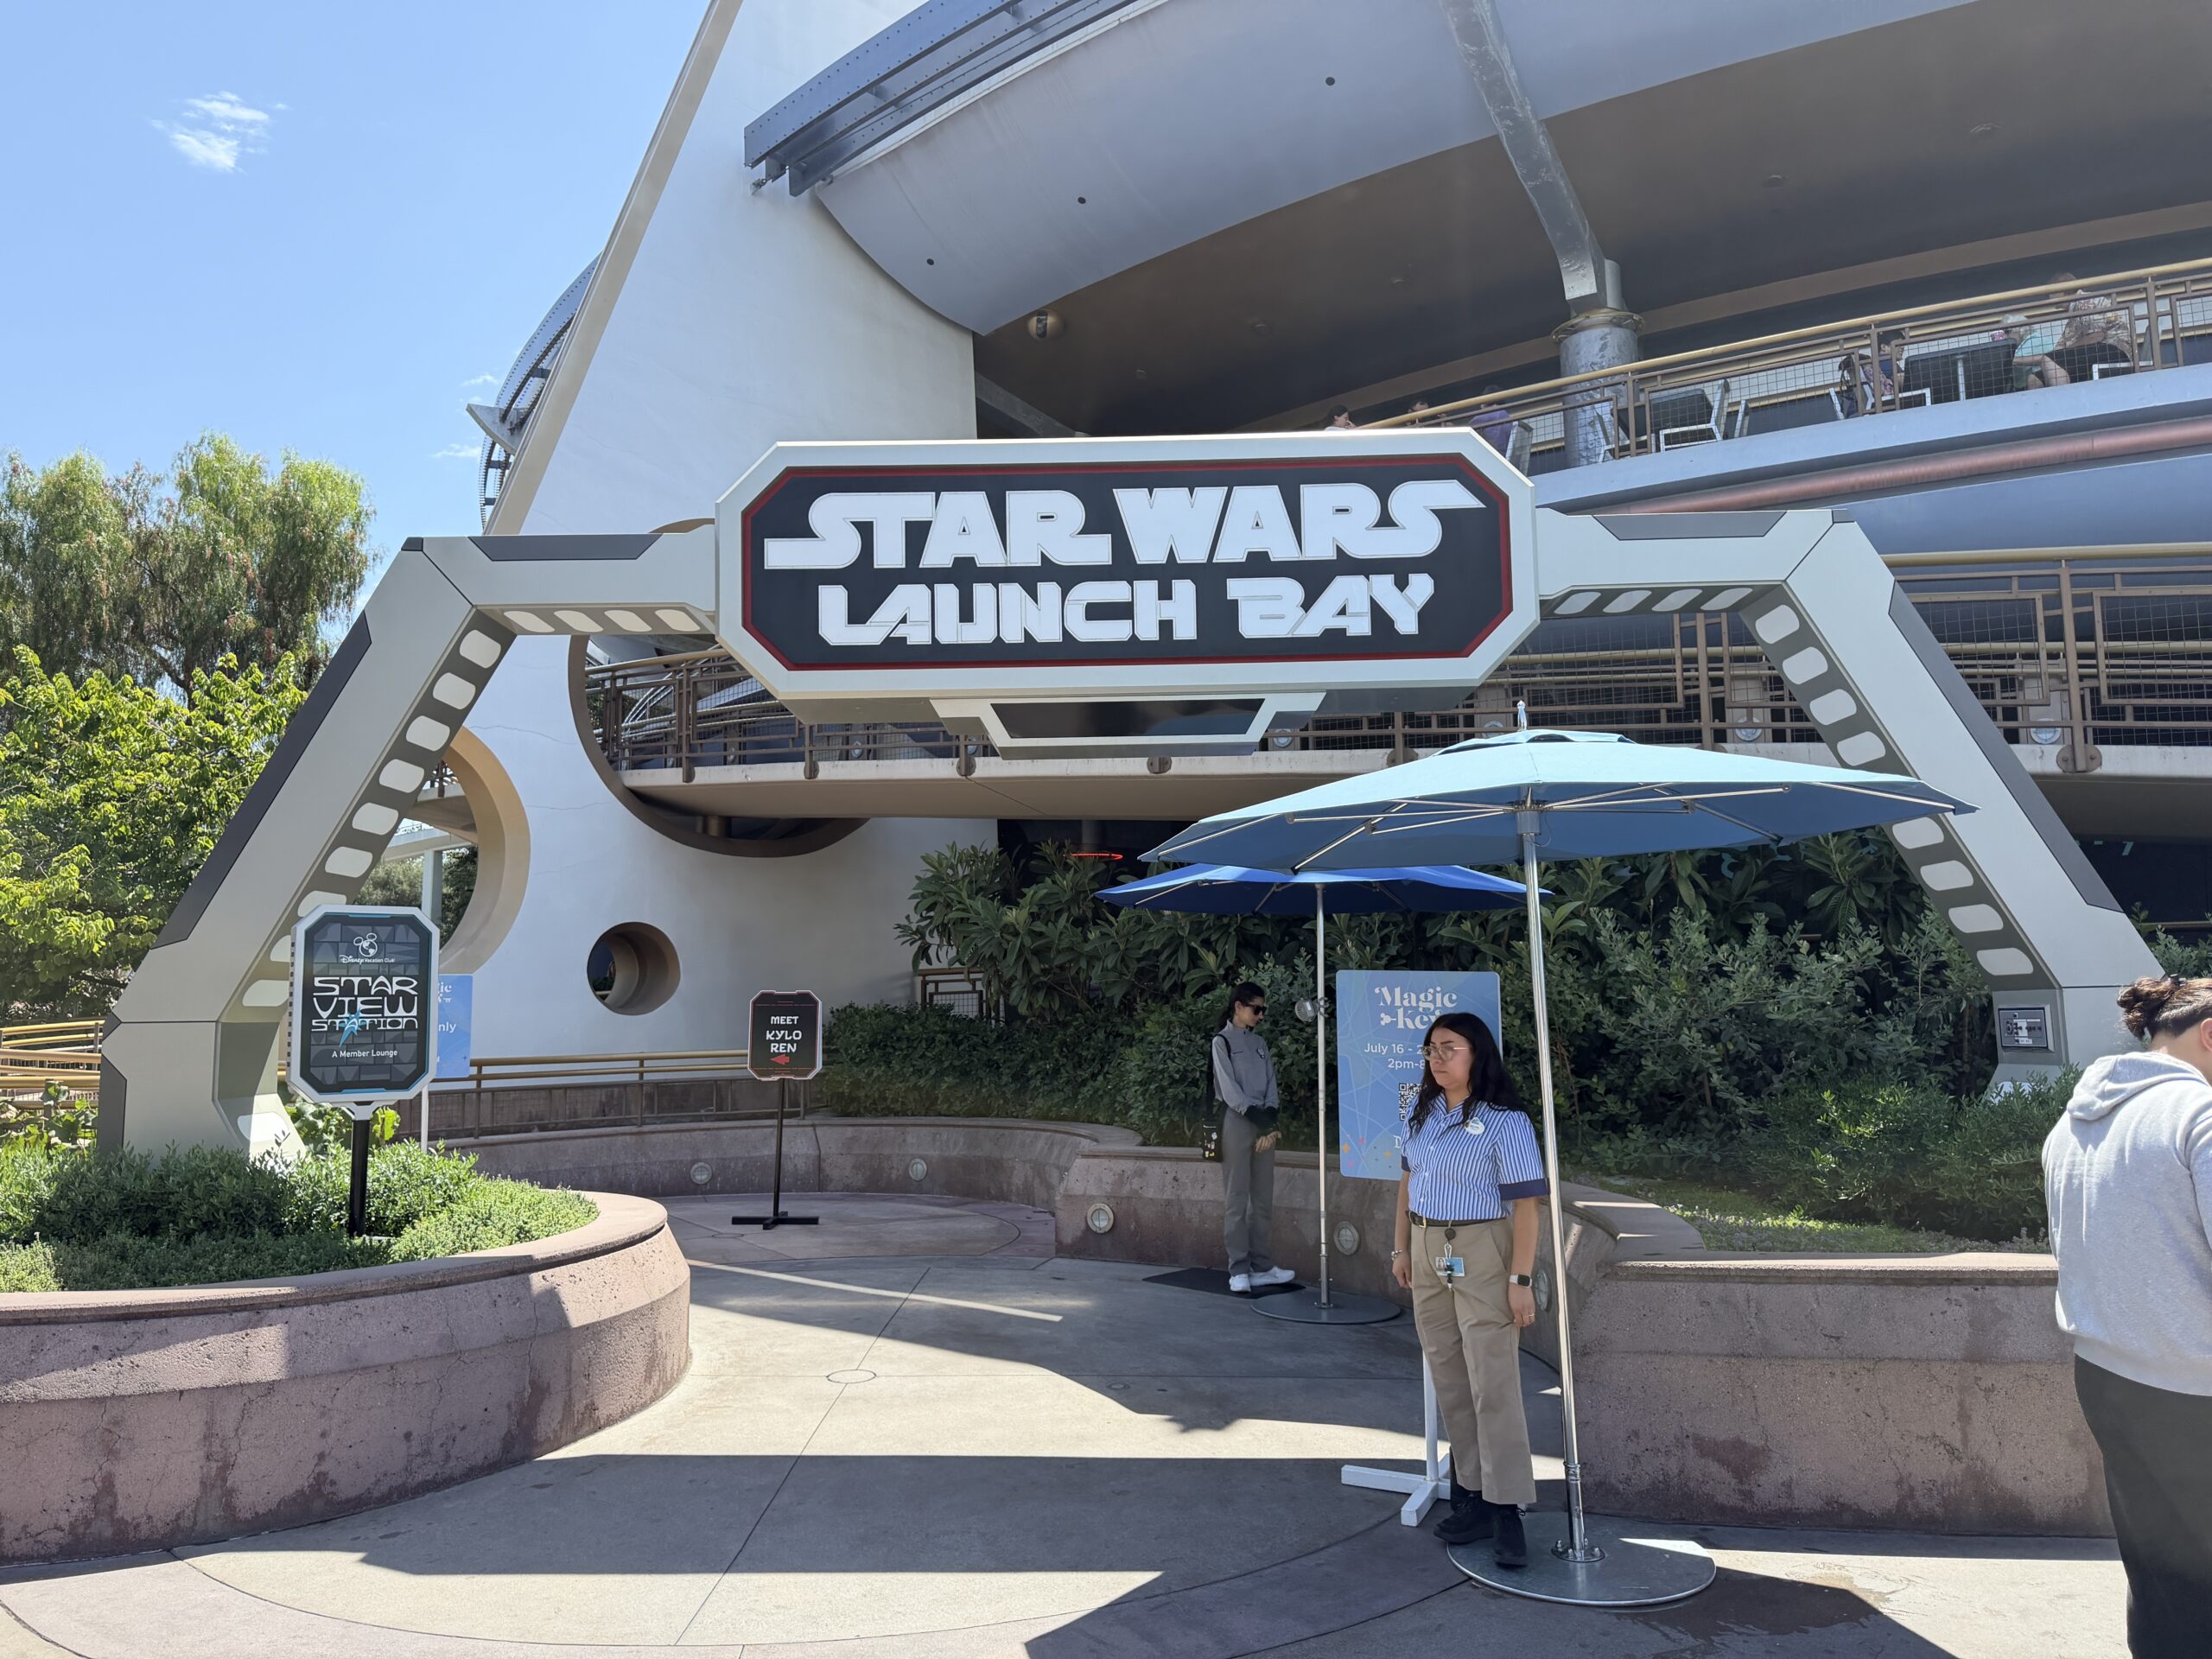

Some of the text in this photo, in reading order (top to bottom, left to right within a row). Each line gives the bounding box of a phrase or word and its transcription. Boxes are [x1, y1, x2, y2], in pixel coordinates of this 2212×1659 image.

[764, 480, 1486, 569] STAR WARS
[818, 574, 1434, 646] LAUNCH BAY
[339, 955, 365, 965] Disney
[313, 976, 418, 995] STAR
[1375, 986, 1458, 1013] Magic
[313, 996, 418, 1019] VIEW
[311, 1018, 418, 1032] STATION
[771, 1016, 799, 1025] MEET
[438, 1021, 456, 1033] nly
[766, 1030, 803, 1040] KYLO
[340, 1050, 370, 1058] Member
[372, 1050, 398, 1058] Lounge
[771, 1043, 797, 1053] REN
[1363, 1044, 1388, 1055] July
[1391, 1044, 1404, 1053] 16
[1416, 1044, 1424, 1054] 2
[1387, 1058, 1425, 1071] 2pm-8
